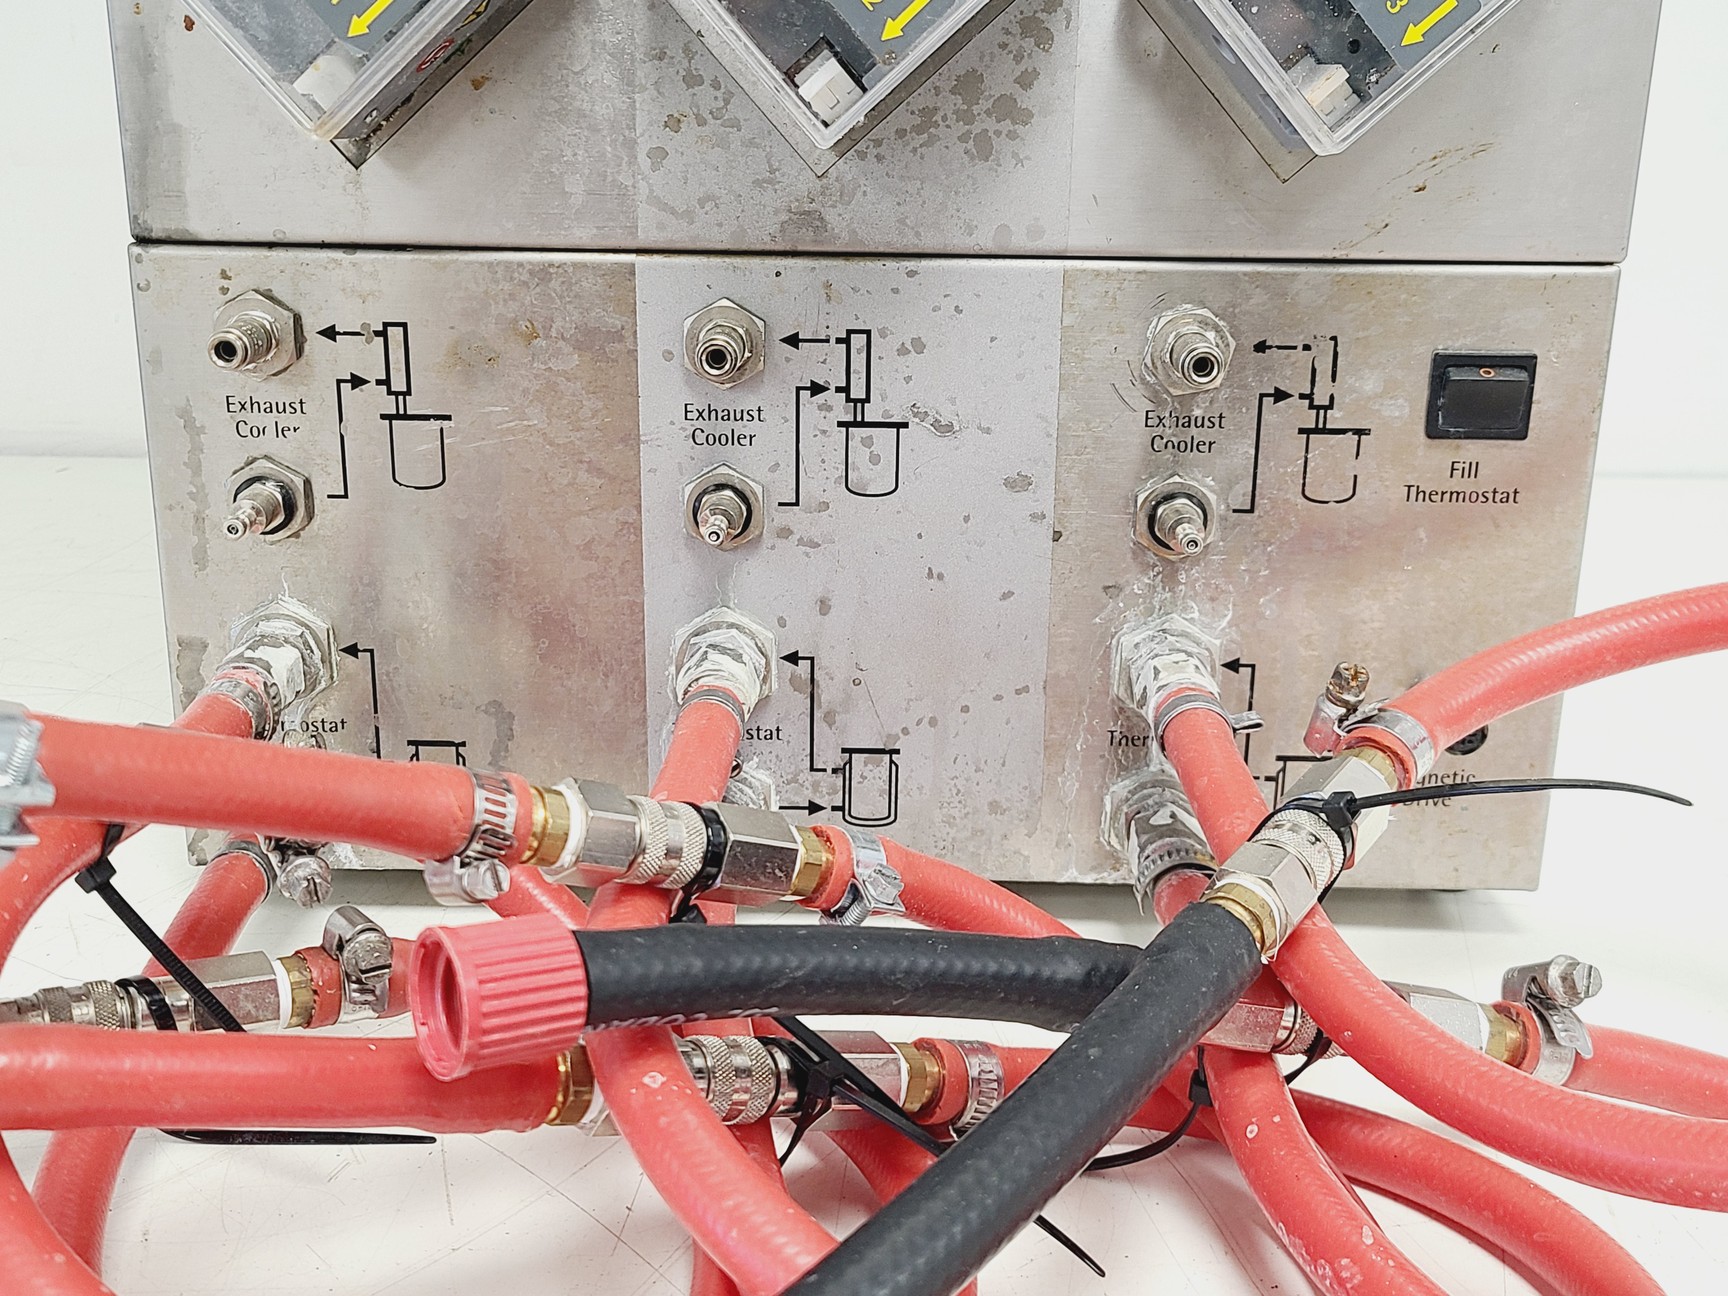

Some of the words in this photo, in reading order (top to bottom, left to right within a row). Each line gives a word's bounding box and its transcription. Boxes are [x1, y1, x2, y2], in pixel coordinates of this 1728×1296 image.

[225, 395, 307, 415] Exhaust
[684, 402, 765, 423] Exhaust
[1144, 409, 1226, 429] Exhaust
[691, 427, 757, 447] Cooler
[1150, 434, 1217, 454] Cooler
[1449, 460, 1480, 479] Fill
[1403, 484, 1520, 504] Thermostat
